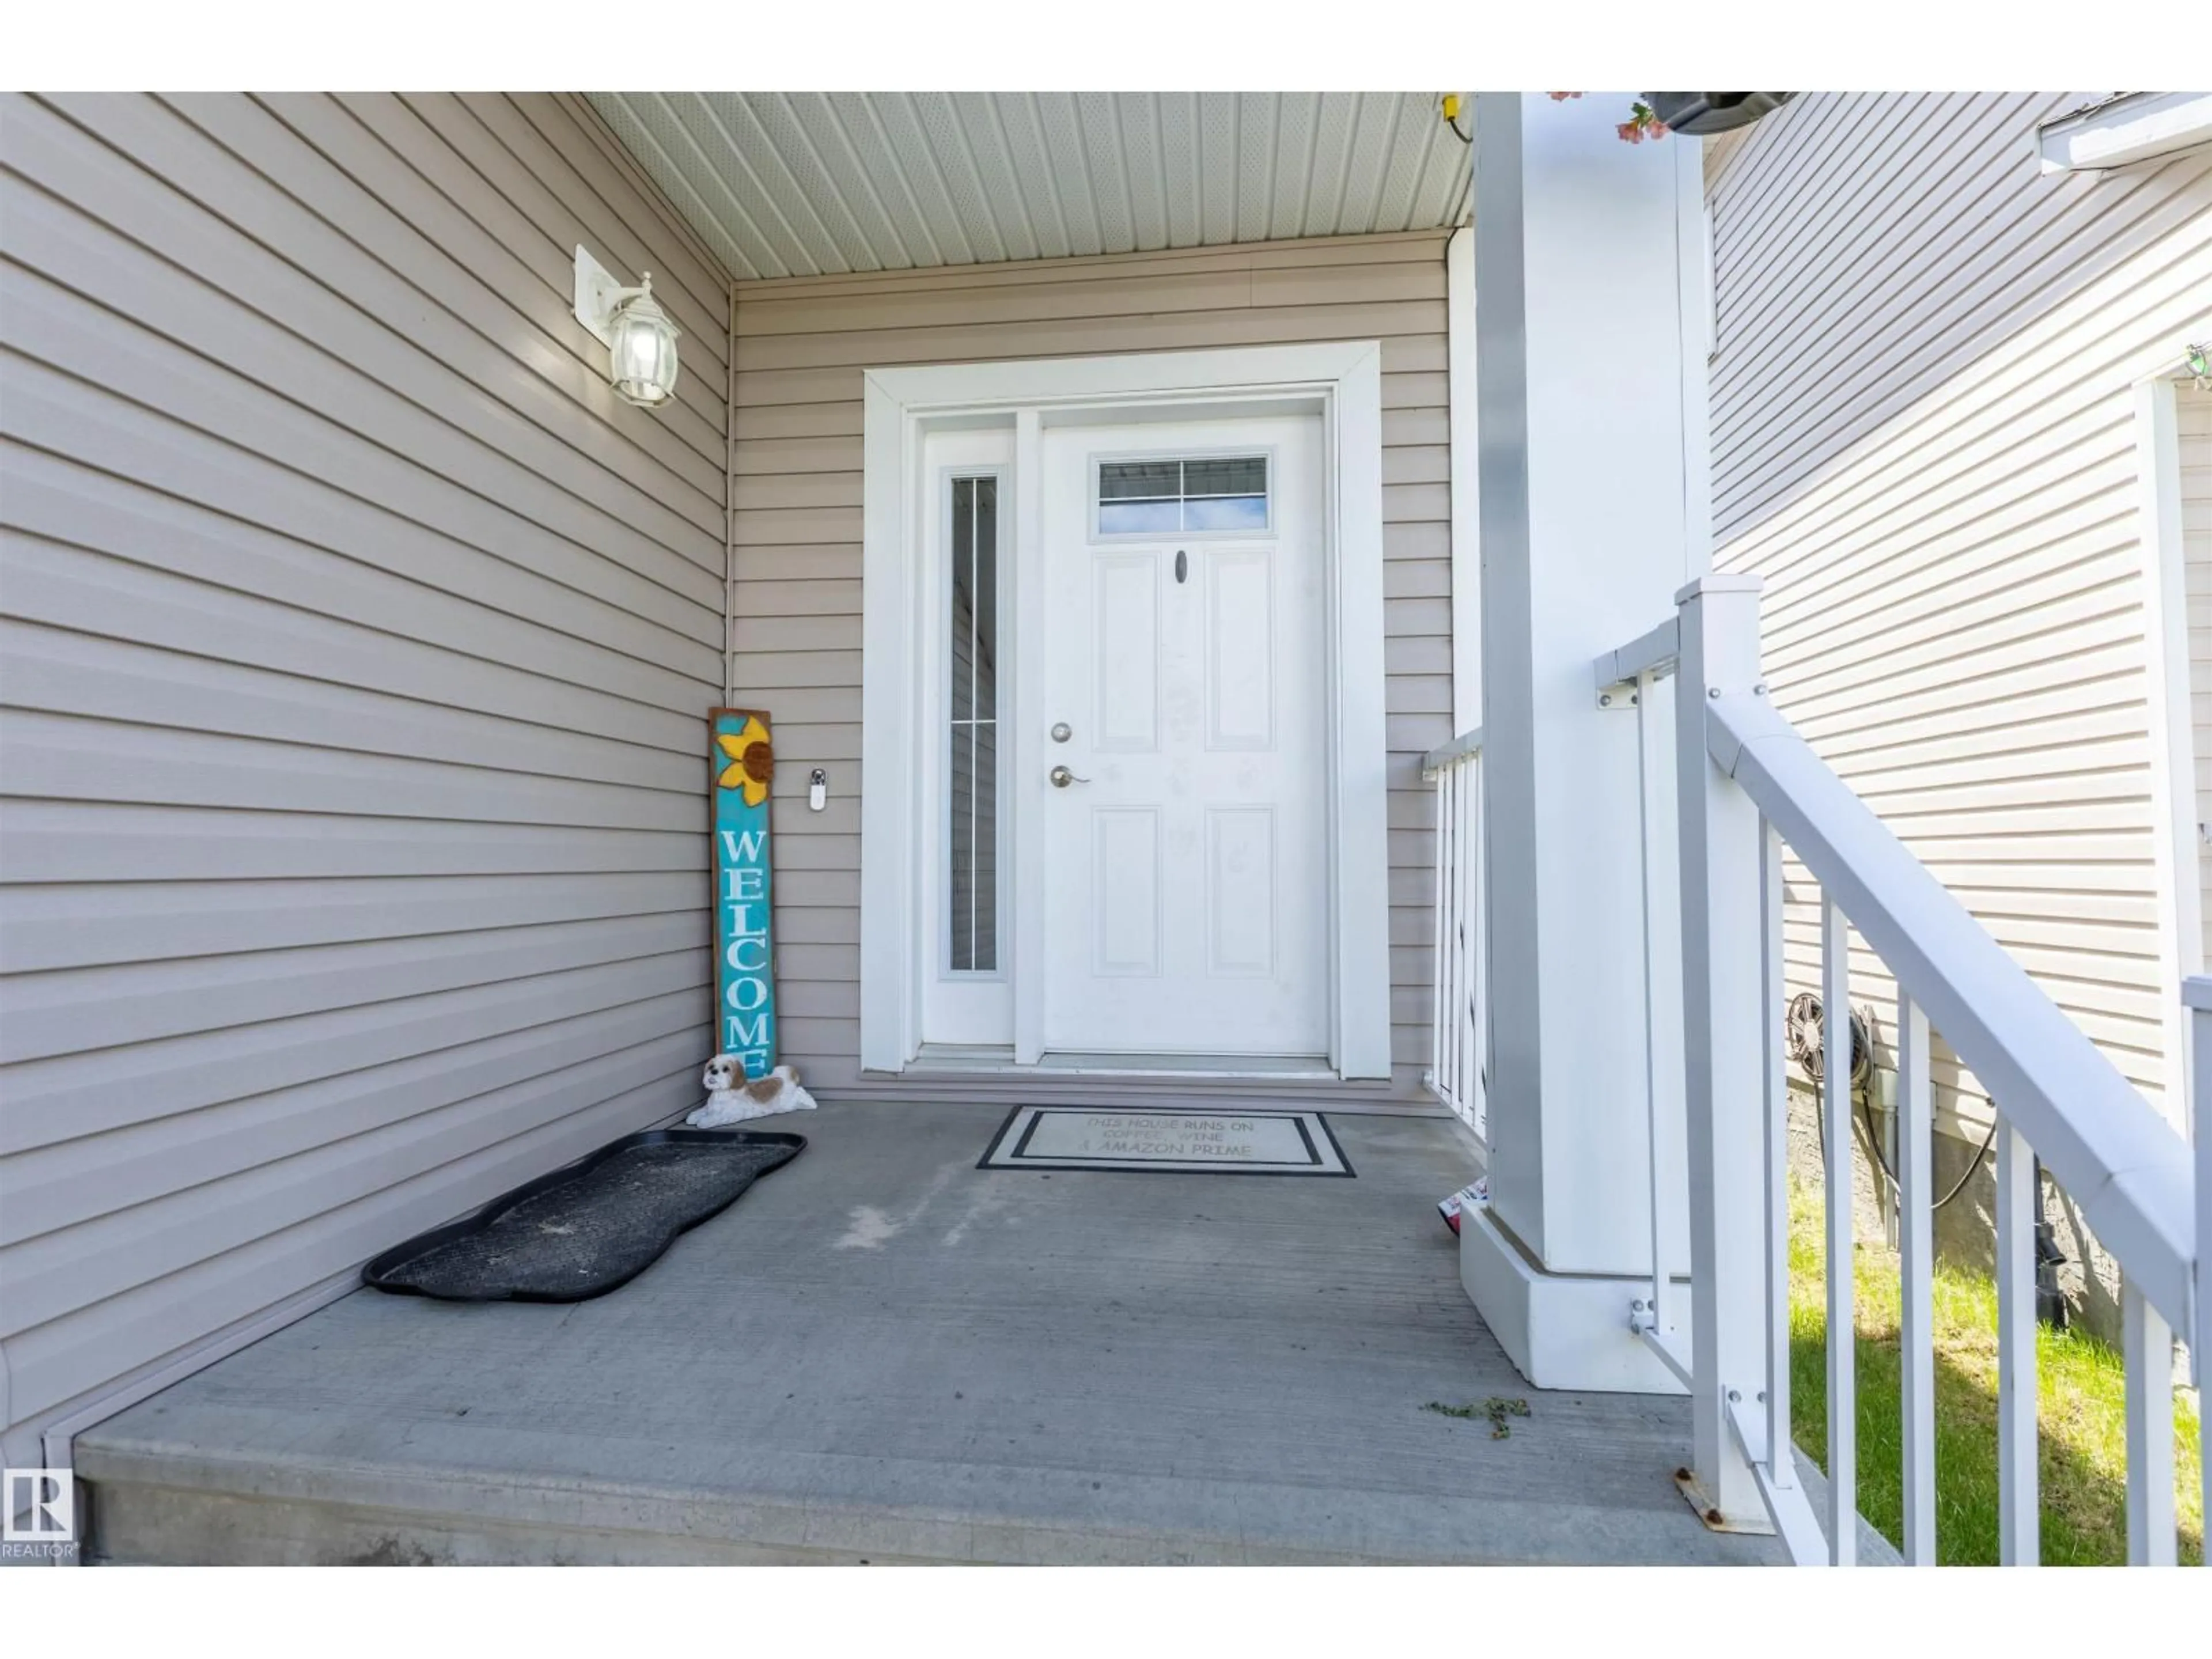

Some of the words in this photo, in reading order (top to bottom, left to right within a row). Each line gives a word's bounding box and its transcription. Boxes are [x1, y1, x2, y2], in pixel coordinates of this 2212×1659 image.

[721, 830, 770, 1084] WELCOME
[1086, 1118, 1123, 1127] THIS
[1128, 1118, 1179, 1130] HOUSE
[1184, 1120, 1225, 1131] RUNS
[1230, 1121, 1254, 1132] ON
[1177, 1130, 1224, 1142] WINE
[1096, 1140, 1184, 1154] AMAZON
[1191, 1143, 1252, 1157] PRIME
